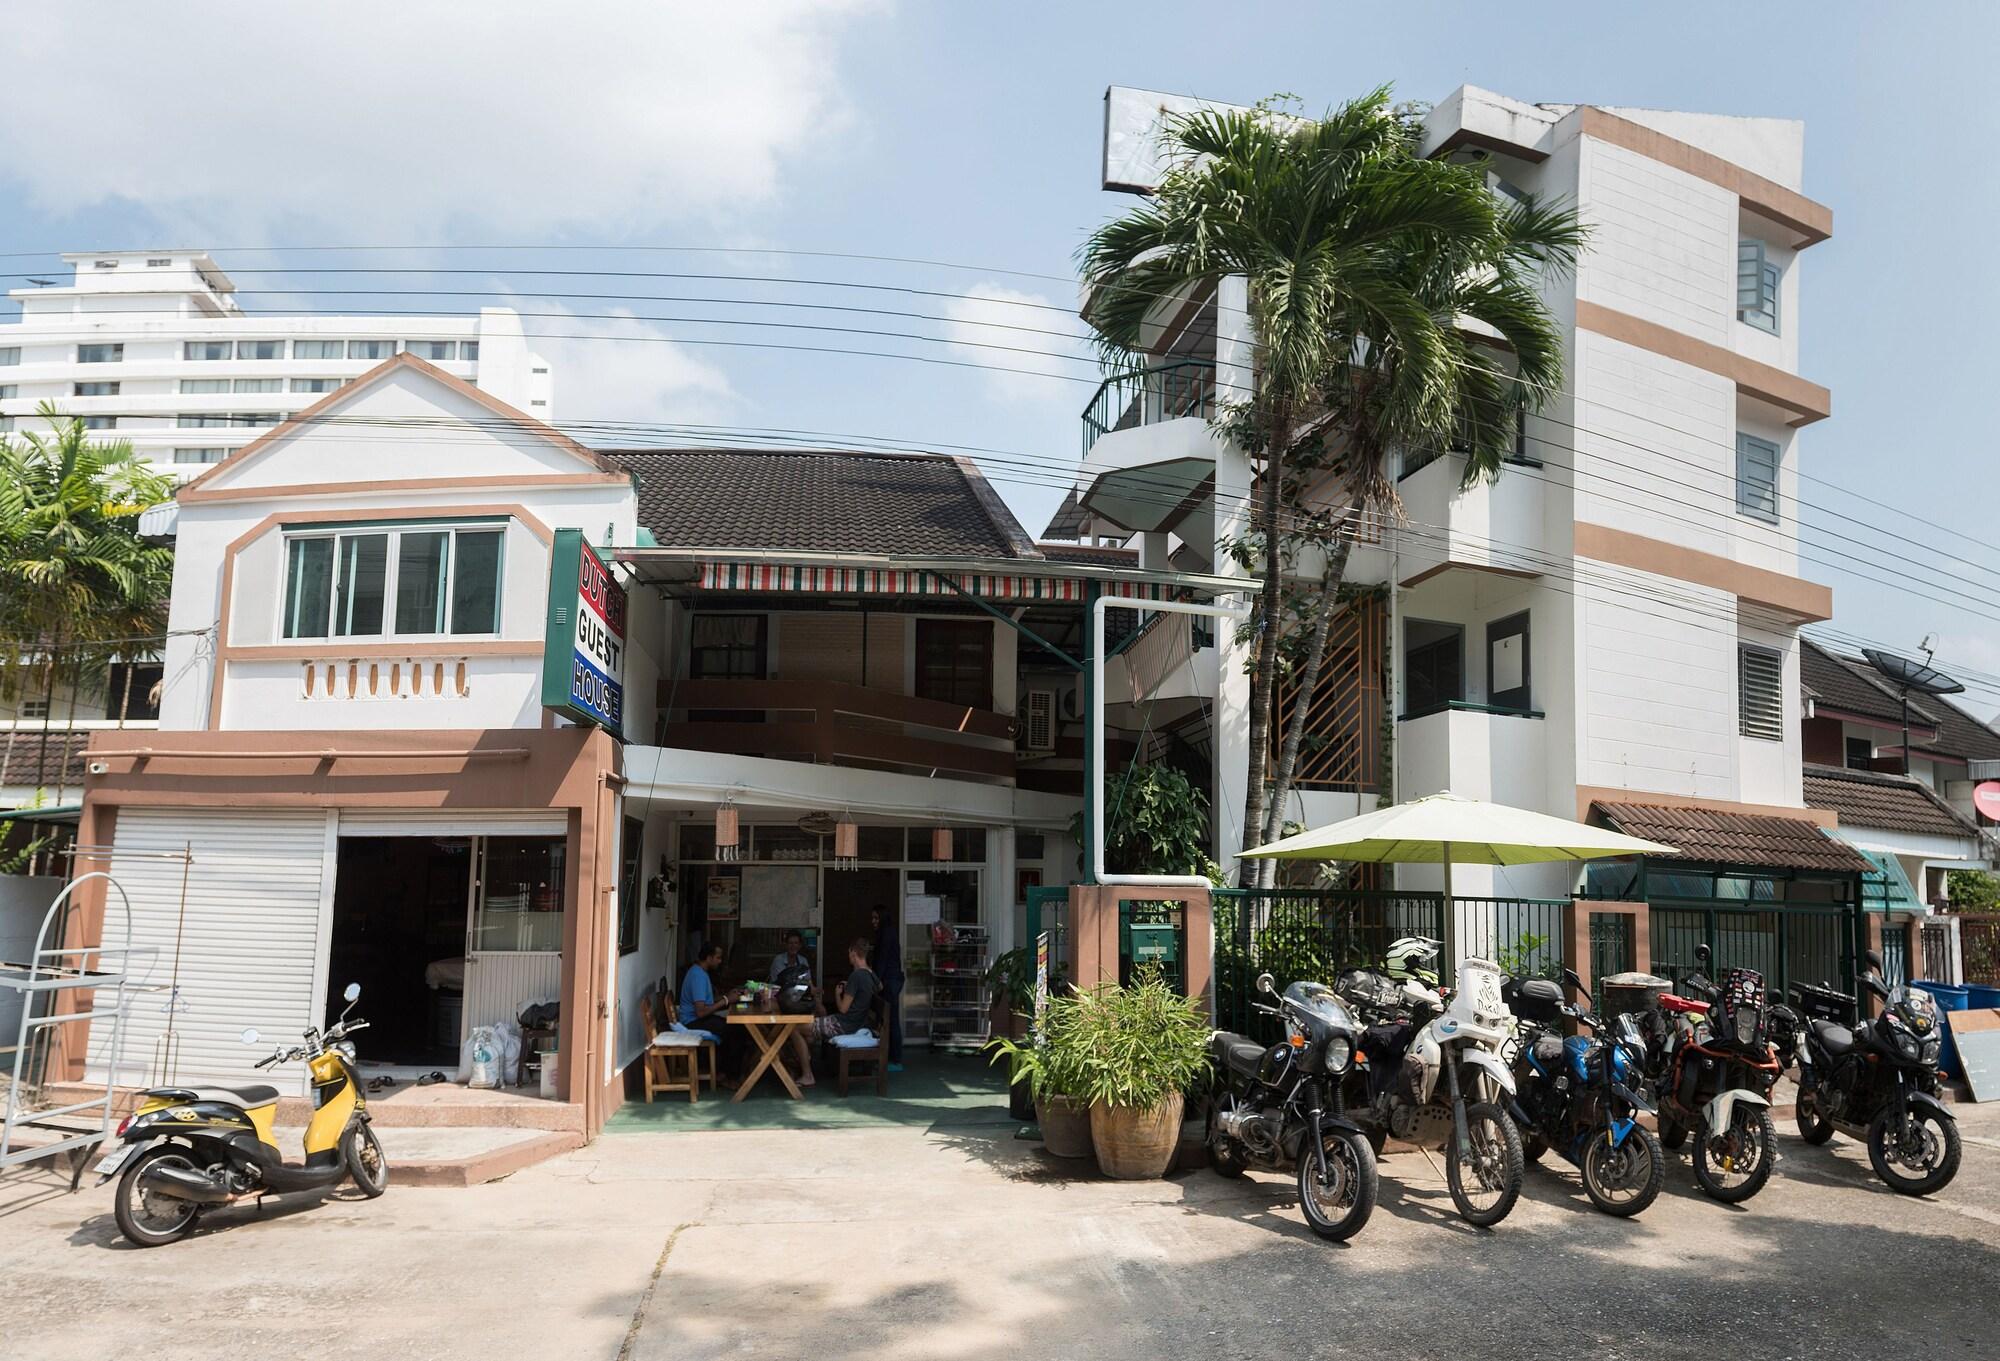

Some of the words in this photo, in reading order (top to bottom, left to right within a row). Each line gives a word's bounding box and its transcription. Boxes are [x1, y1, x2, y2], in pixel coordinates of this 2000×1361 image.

[581, 550, 624, 630] DUTCH
[578, 608, 620, 672] GUEST
[573, 658, 620, 721] HOUSE
